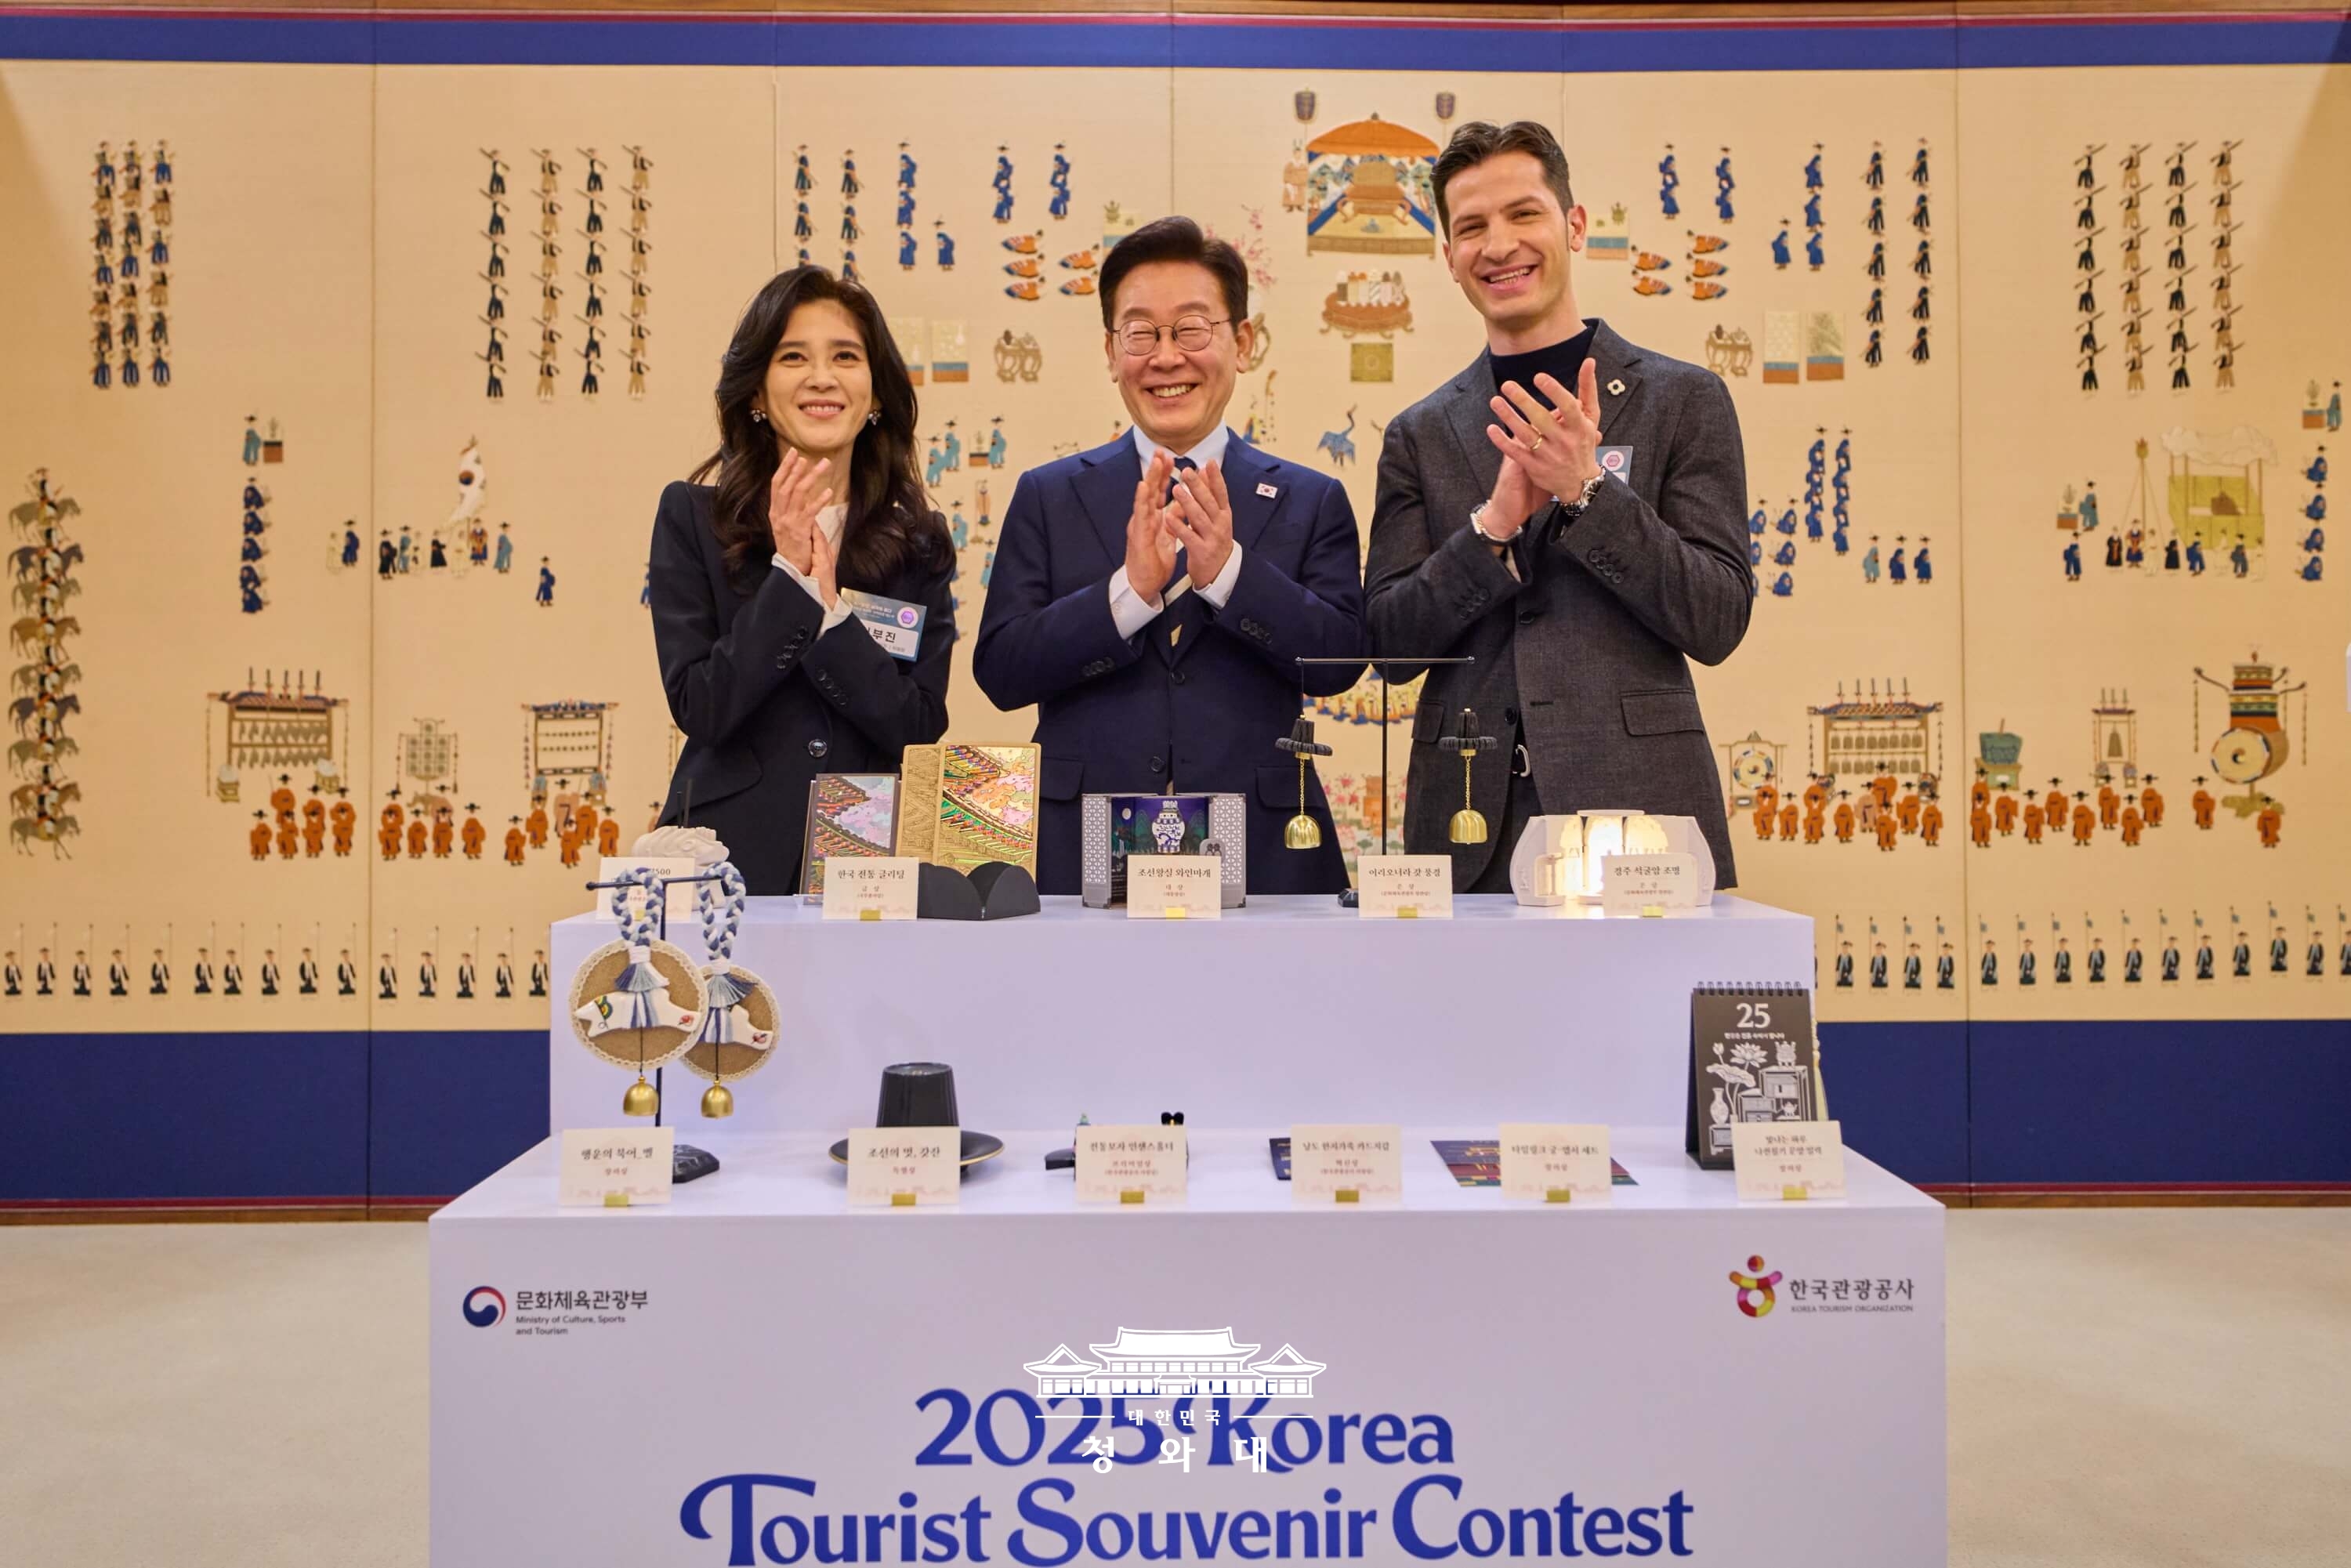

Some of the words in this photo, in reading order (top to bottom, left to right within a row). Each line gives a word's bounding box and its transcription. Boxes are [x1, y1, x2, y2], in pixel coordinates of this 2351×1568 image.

[868, 628, 897, 643] 부진
[838, 870, 855, 878] 한국
[858, 870, 875, 878] 전통
[1138, 867, 1173, 878] 조선왕실
[1176, 867, 1212, 878] 와인마개
[1369, 867, 1411, 877] 이리오너라
[1425, 867, 1440, 877] 풍경
[1614, 866, 1631, 876] 경주
[1635, 866, 1661, 875] 석굴암
[1663, 866, 1680, 875] 조명
[1736, 1002, 1771, 1028] 25
[581, 1147, 612, 1161] 행운의
[868, 1146, 900, 1158] 조선의
[1789, 1279, 1914, 1301] 한국관광공사
[516, 1290, 648, 1310] 문화체육관광부
[1854, 1304, 1914, 1313] ORGANIZATION
[516, 1316, 549, 1325] Ministry
[563, 1316, 596, 1324] Culture,
[598, 1316, 625, 1325] Sports
[915, 1387, 1165, 1467] 2025
[1173, 1382, 1454, 1474] Korea
[679, 1474, 991, 1566] Tourist
[1007, 1478, 1377, 1568] Souvenir
[1392, 1474, 1694, 1559] Contest
